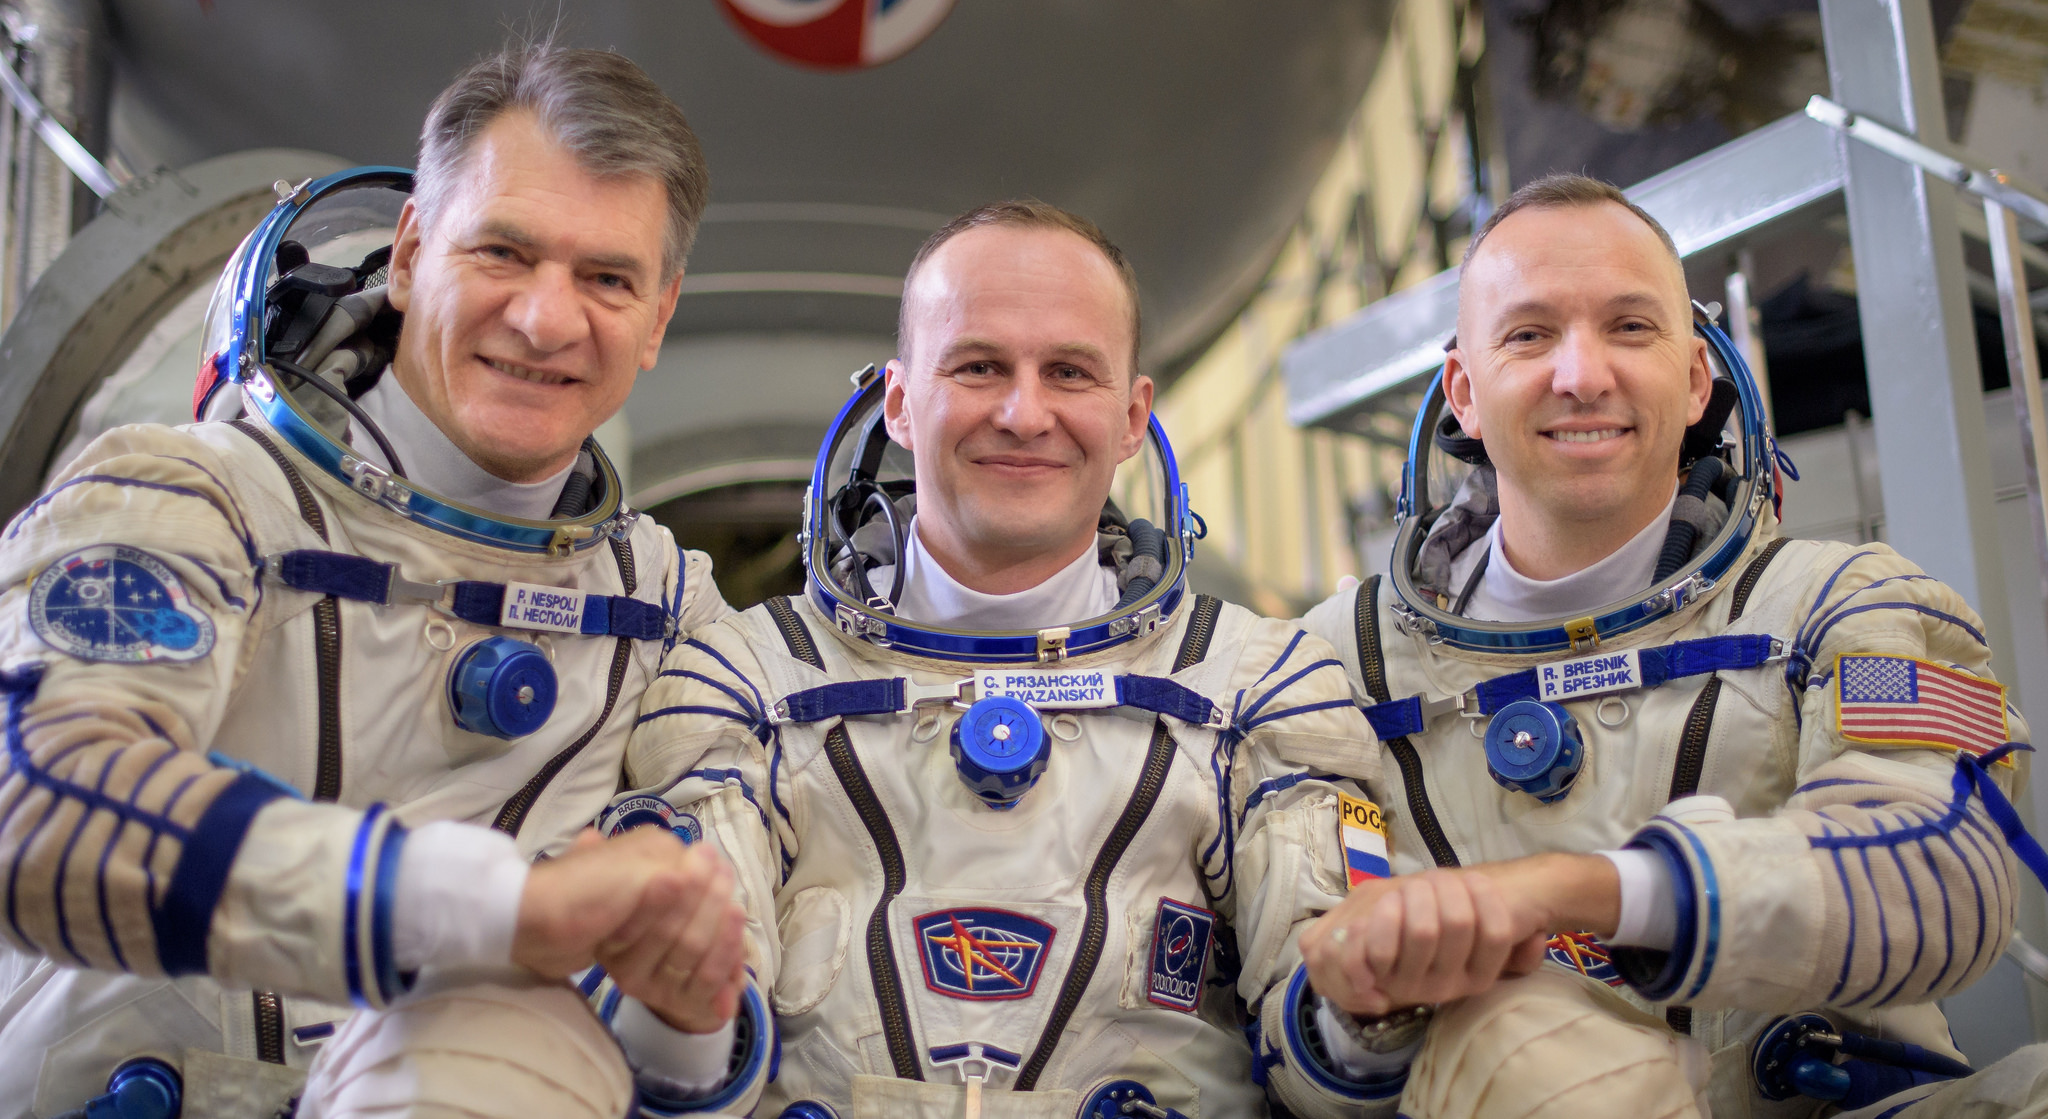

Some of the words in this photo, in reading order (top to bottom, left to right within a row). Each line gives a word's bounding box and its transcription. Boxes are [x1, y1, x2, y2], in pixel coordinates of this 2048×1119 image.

[517, 589, 526, 603] P.
[530, 592, 578, 612] NESPOLI
[509, 604, 519, 619] П.
[523, 607, 579, 628] НЕСПОЛИ
[1543, 667, 1558, 680] R.
[1563, 654, 1629, 678] BRESNIK
[983, 676, 1000, 688] С.
[1006, 672, 1104, 688] РЯЗАНСКИЙ
[1563, 669, 1633, 693] БРЕЗНИК
[1005, 688, 1104, 702] RYAZANSKIY
[618, 799, 660, 817] BRESNIK
[1343, 801, 1382, 830] РОС
